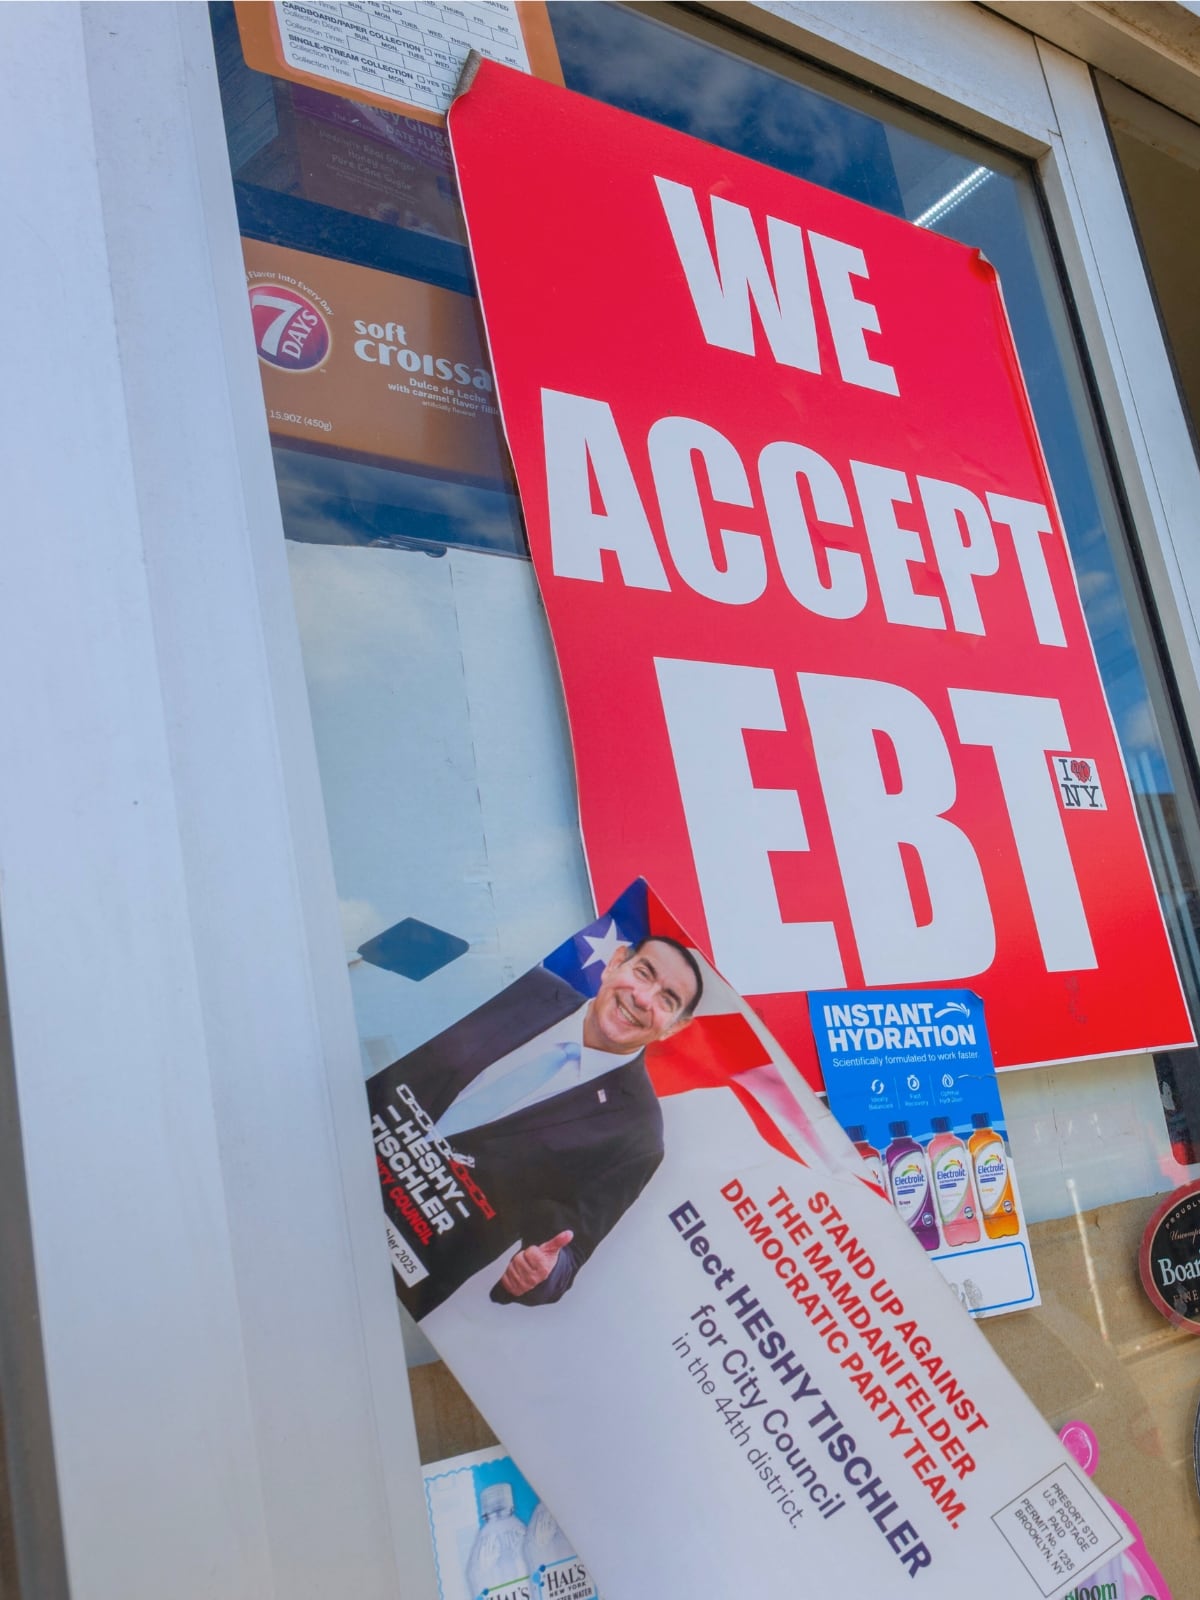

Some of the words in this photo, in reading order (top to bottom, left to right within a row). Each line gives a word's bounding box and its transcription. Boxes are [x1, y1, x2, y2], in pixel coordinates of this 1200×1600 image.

[282, 1, 368, 34] CARDBOARD/PAPER
[368, 29, 421, 53] COLLECTION
[288, 34, 360, 62] SINGLE-STREAM
[360, 58, 414, 80] COLLECTION
[278, 273, 297, 285] Into
[297, 281, 322, 301] Every
[320, 299, 334, 316] Day
[653, 175, 900, 397] WE
[251, 294, 303, 357] 7
[281, 309, 319, 360] DAYS
[353, 320, 407, 345] soft
[354, 339, 492, 392] croissa
[388, 383, 410, 395] with
[413, 390, 451, 404] caramel
[452, 398, 479, 411] flavor
[409, 378, 439, 392] Dulce
[442, 384, 455, 396] de
[457, 388, 487, 404] Leche
[304, 416, 333, 432] (450g)
[540, 387, 1069, 648] ACCEPT
[1058, 759, 1073, 781] I
[1061, 784, 1099, 807] NY
[653, 656, 1099, 996] EBT
[823, 1003, 934, 1028] INSTANT
[827, 1024, 977, 1053] HYDRATION
[832, 1056, 884, 1068] Scientifically
[885, 1053, 927, 1064] formulated
[928, 1053, 936, 1062] to
[937, 1052, 957, 1061] work
[371, 1113, 455, 1235] TISCHLER
[395, 1120, 465, 1200] HESHY
[894, 1174, 925, 1186] Electrolit
[937, 1168, 967, 1180] Electrolit
[977, 1163, 1005, 1175] Electrolit
[389, 1186, 433, 1246] COUNCIL
[395, 1249, 418, 1274] 2025
[766, 1185, 813, 1246] THE
[803, 1241, 906, 1376] MAMDANI
[894, 1371, 977, 1481] FELDER
[806, 1191, 876, 1281] STAND
[869, 1278, 905, 1317] UP
[893, 1319, 990, 1435] AGAINST
[719, 1178, 850, 1355] DEMOCRATIC
[839, 1352, 915, 1441] PARTY
[902, 1437, 967, 1531] TEAM.
[667, 1200, 736, 1292] Elect
[725, 1283, 823, 1403] HESHY
[807, 1399, 933, 1579] TISCHLER
[690, 1304, 729, 1348] for
[721, 1348, 768, 1411] City
[762, 1408, 847, 1520] Council
[671, 1331, 692, 1360] in
[687, 1356, 717, 1396] the
[714, 1396, 752, 1448] 44th
[746, 1447, 805, 1531] district.
[1021, 1498, 1052, 1533] PERMIT
[1045, 1531, 1058, 1549] No.
[1057, 1549, 1076, 1572] 1235
[1041, 1490, 1057, 1510] U.S.
[1057, 1508, 1091, 1553] POSTAGE
[1047, 1515, 1066, 1539] PAID
[1050, 1482, 1089, 1526] PRESORT
[1081, 1525, 1099, 1546] STD
[547, 1564, 587, 1591] HAL'S
[568, 1581, 587, 1591] YORK
[1051, 1561, 1066, 1576] NY
[573, 1587, 593, 1600] WATER
